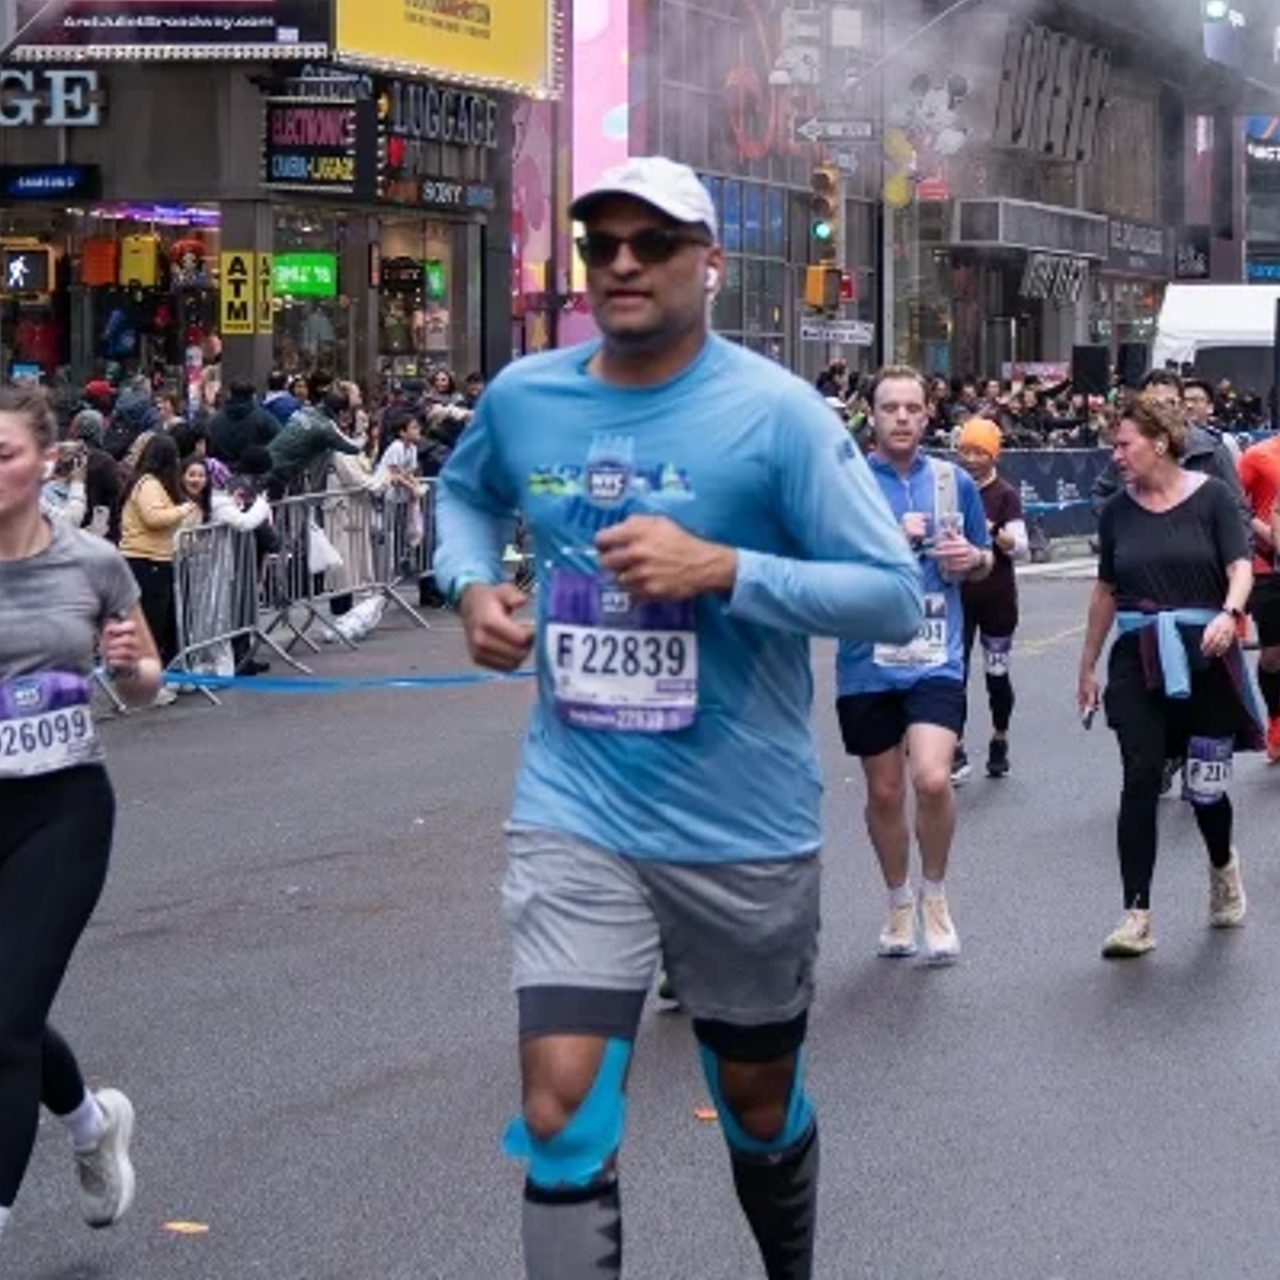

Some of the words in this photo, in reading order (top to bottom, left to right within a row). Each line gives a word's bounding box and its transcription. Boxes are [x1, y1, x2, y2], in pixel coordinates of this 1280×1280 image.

[392, 80, 498, 148] LUGGAGE
[423, 181, 462, 205] SONY
[226, 256, 249, 321] ATM
[557, 633, 574, 668] F
[581, 635, 686, 678] 22839
